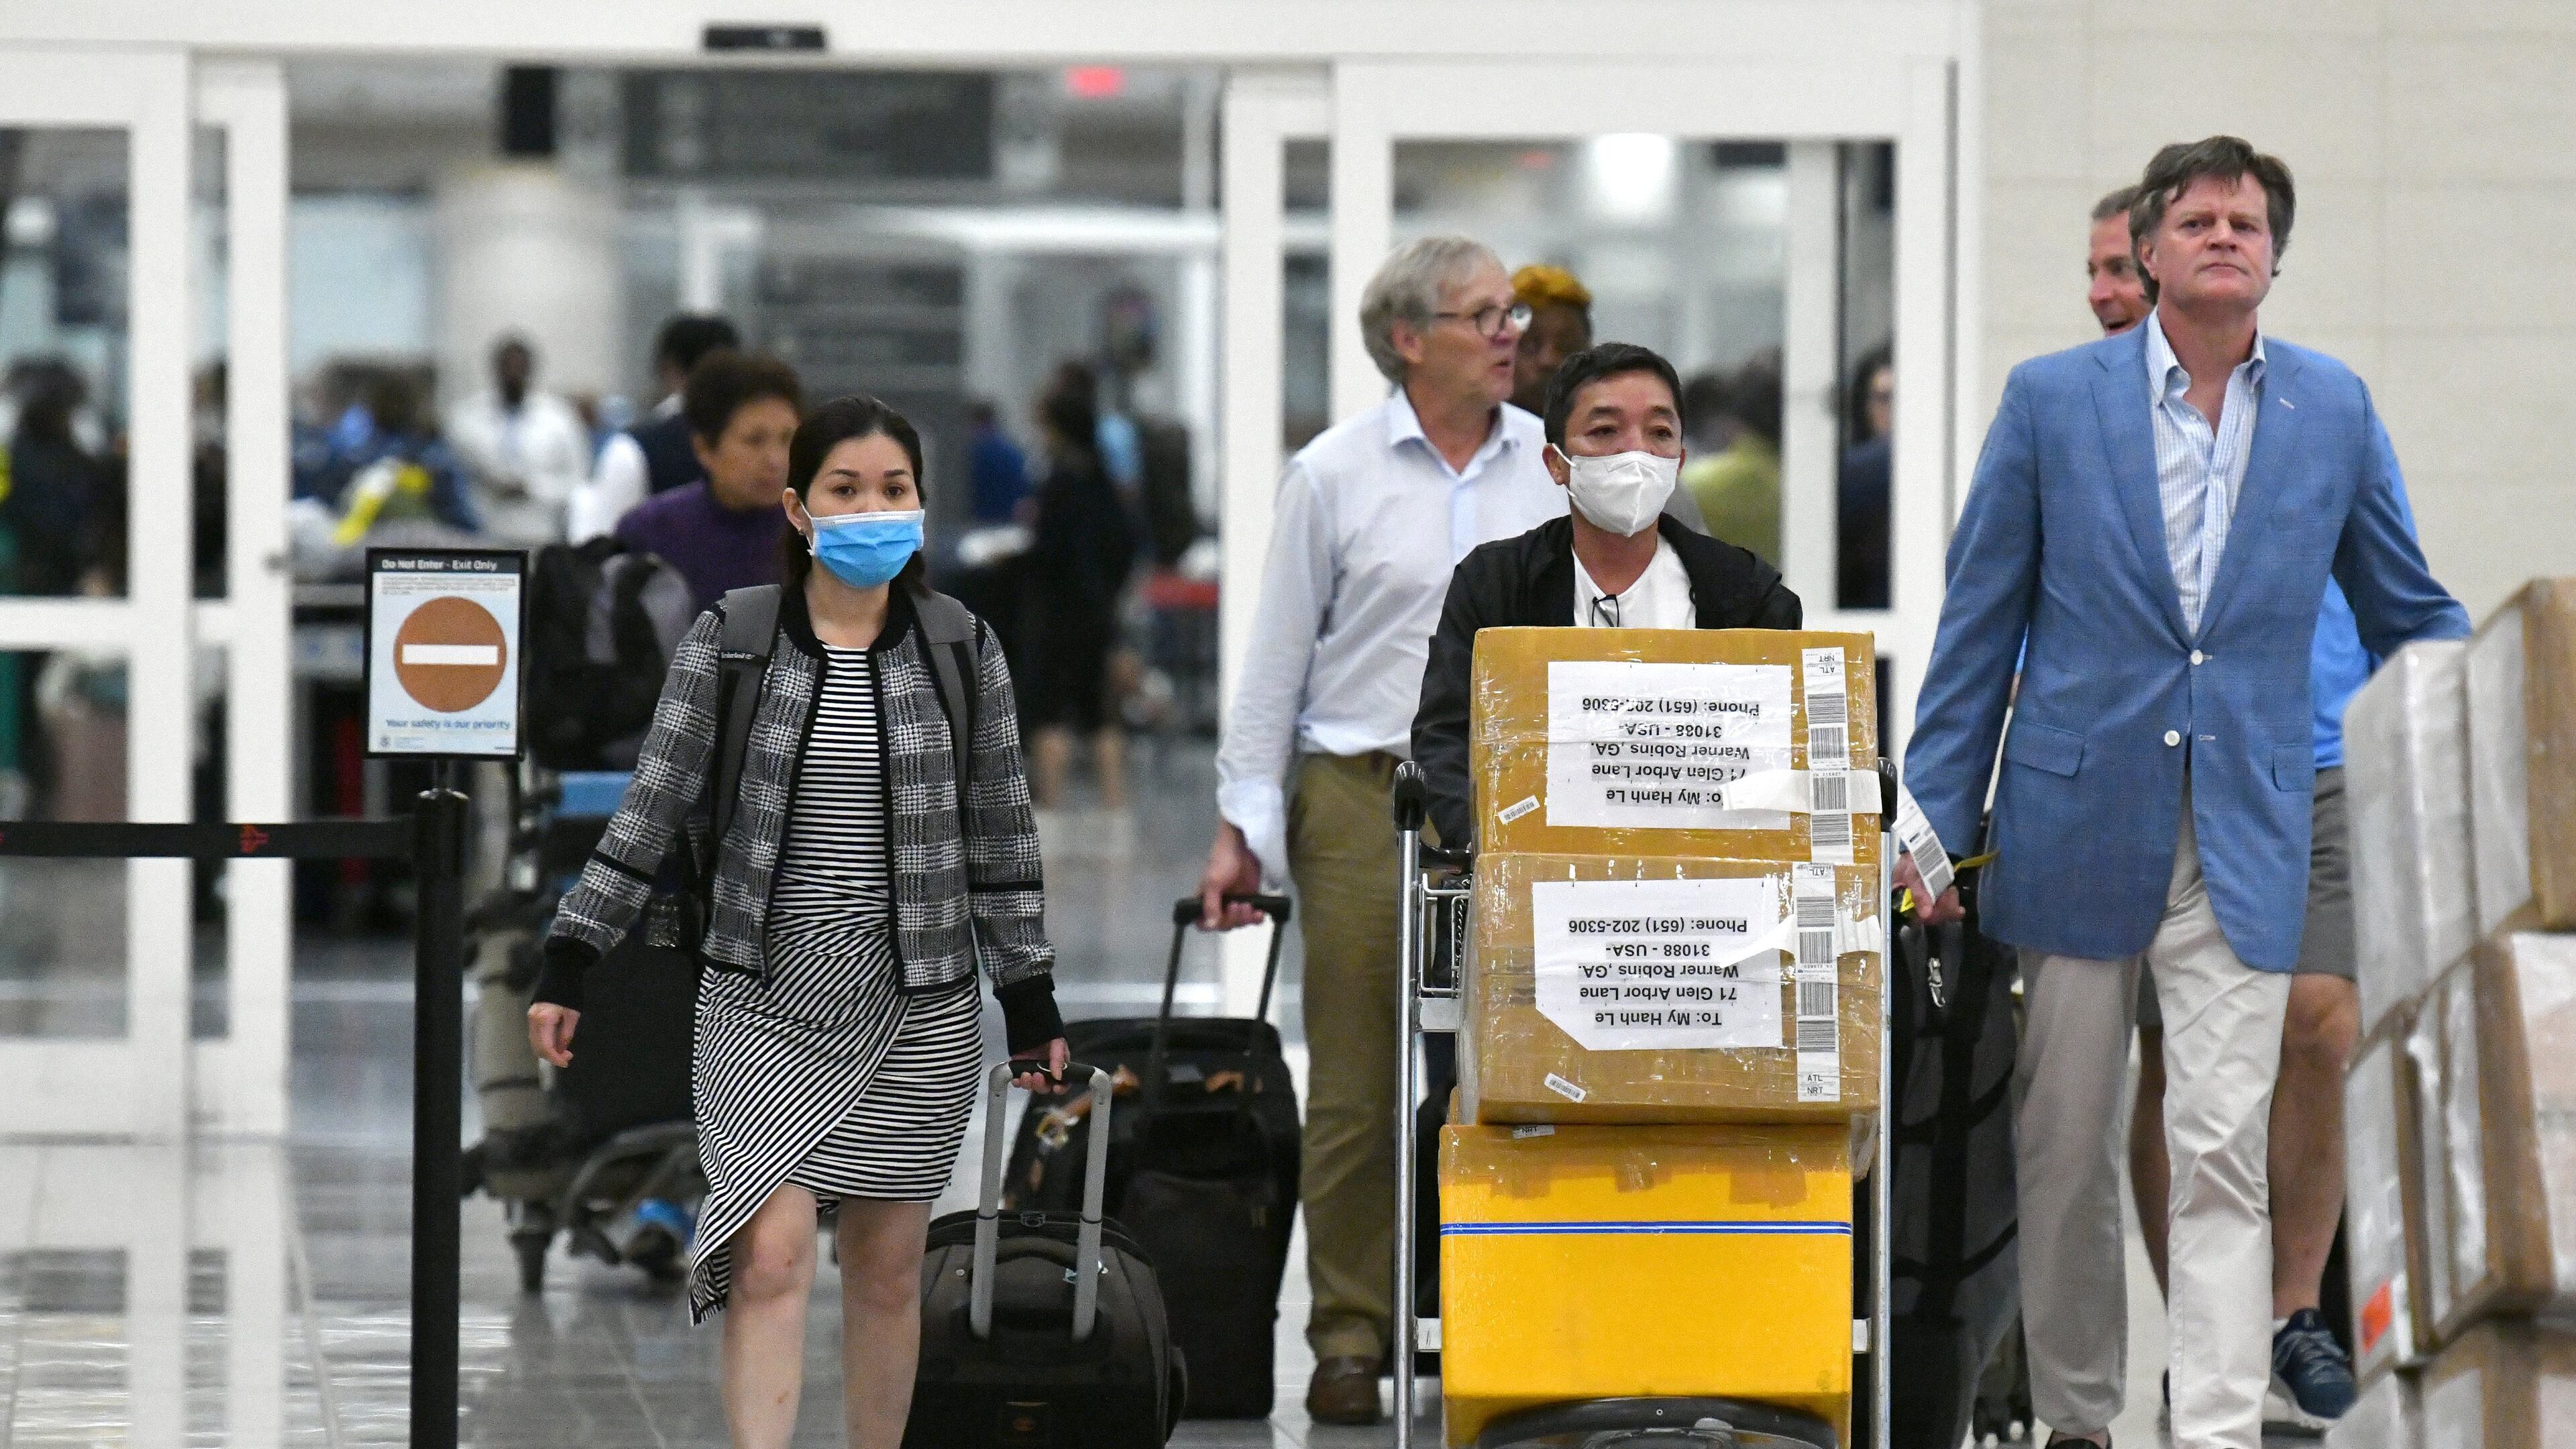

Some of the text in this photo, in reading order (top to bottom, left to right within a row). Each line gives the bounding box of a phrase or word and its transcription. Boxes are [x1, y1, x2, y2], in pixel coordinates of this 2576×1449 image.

[382, 559, 396, 569] Do
[398, 559, 415, 569] Not
[417, 559, 443, 569] Enter
[452, 559, 472, 570] Exit
[474, 559, 497, 571] Only
[1659, 697, 1698, 713] (651)
[1704, 702, 1760, 716] Phone:
[411, 720, 440, 729] safety
[443, 719, 451, 727] is
[472, 720, 511, 730] priority
[1676, 725, 1721, 738] 31088
[1631, 745, 1686, 757] Robins
[1692, 747, 1750, 759] Warner
[1592, 765, 1630, 778] Lane
[1635, 765, 1681, 779] Arbor
[1687, 767, 1723, 780] Glen
[1606, 789, 1723, 804] o: My Hanh Le
[1568, 918, 1747, 932] Phone: (651) 202-5306
[1664, 945, 1710, 956] 31088
[1618, 965, 1674, 978] Robins
[1680, 965, 1739, 978] Warner
[1580, 987, 1737, 1000] 71 Glen Arbor Lane
[1595, 1010, 1722, 1025] To: My Hanh Le
